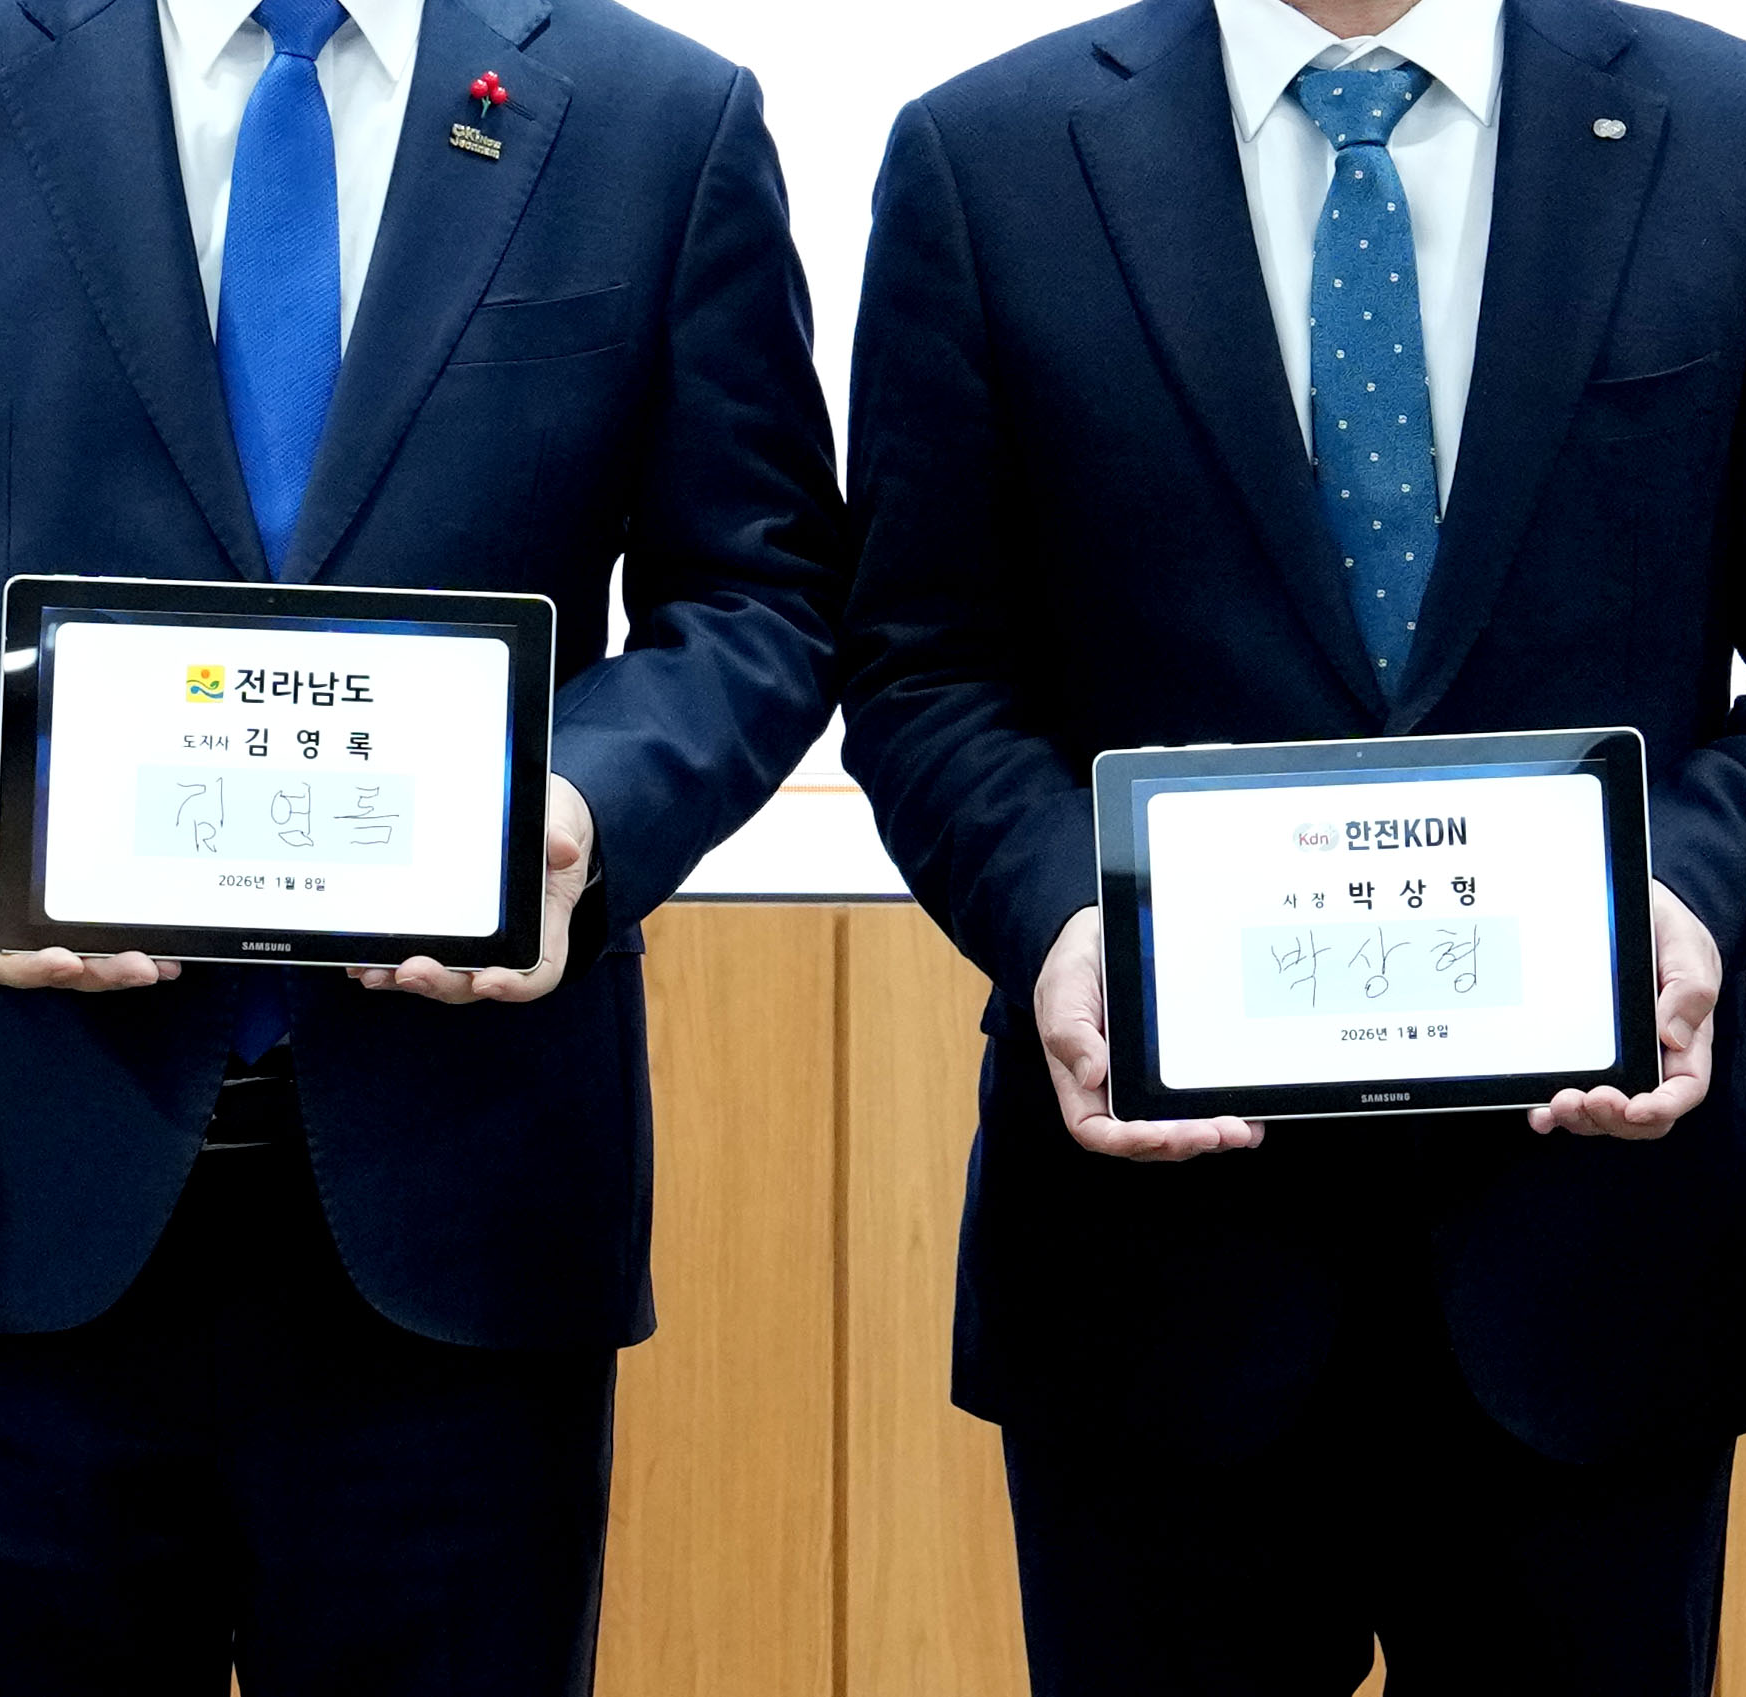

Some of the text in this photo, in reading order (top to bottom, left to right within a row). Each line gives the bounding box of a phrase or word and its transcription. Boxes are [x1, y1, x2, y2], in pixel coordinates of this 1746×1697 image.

[234, 669, 374, 707] 전라남도
[183, 734, 229, 751] 도지사
[1298, 817, 1467, 851] Kdn 한전KDN
[219, 875, 325, 892] 2026년 1월 8일
[242, 942, 291, 952] SAMSUNG
[1341, 1025, 1448, 1041] 2026년 1월 8일
[1360, 1092, 1411, 1103] SAMSUNG
